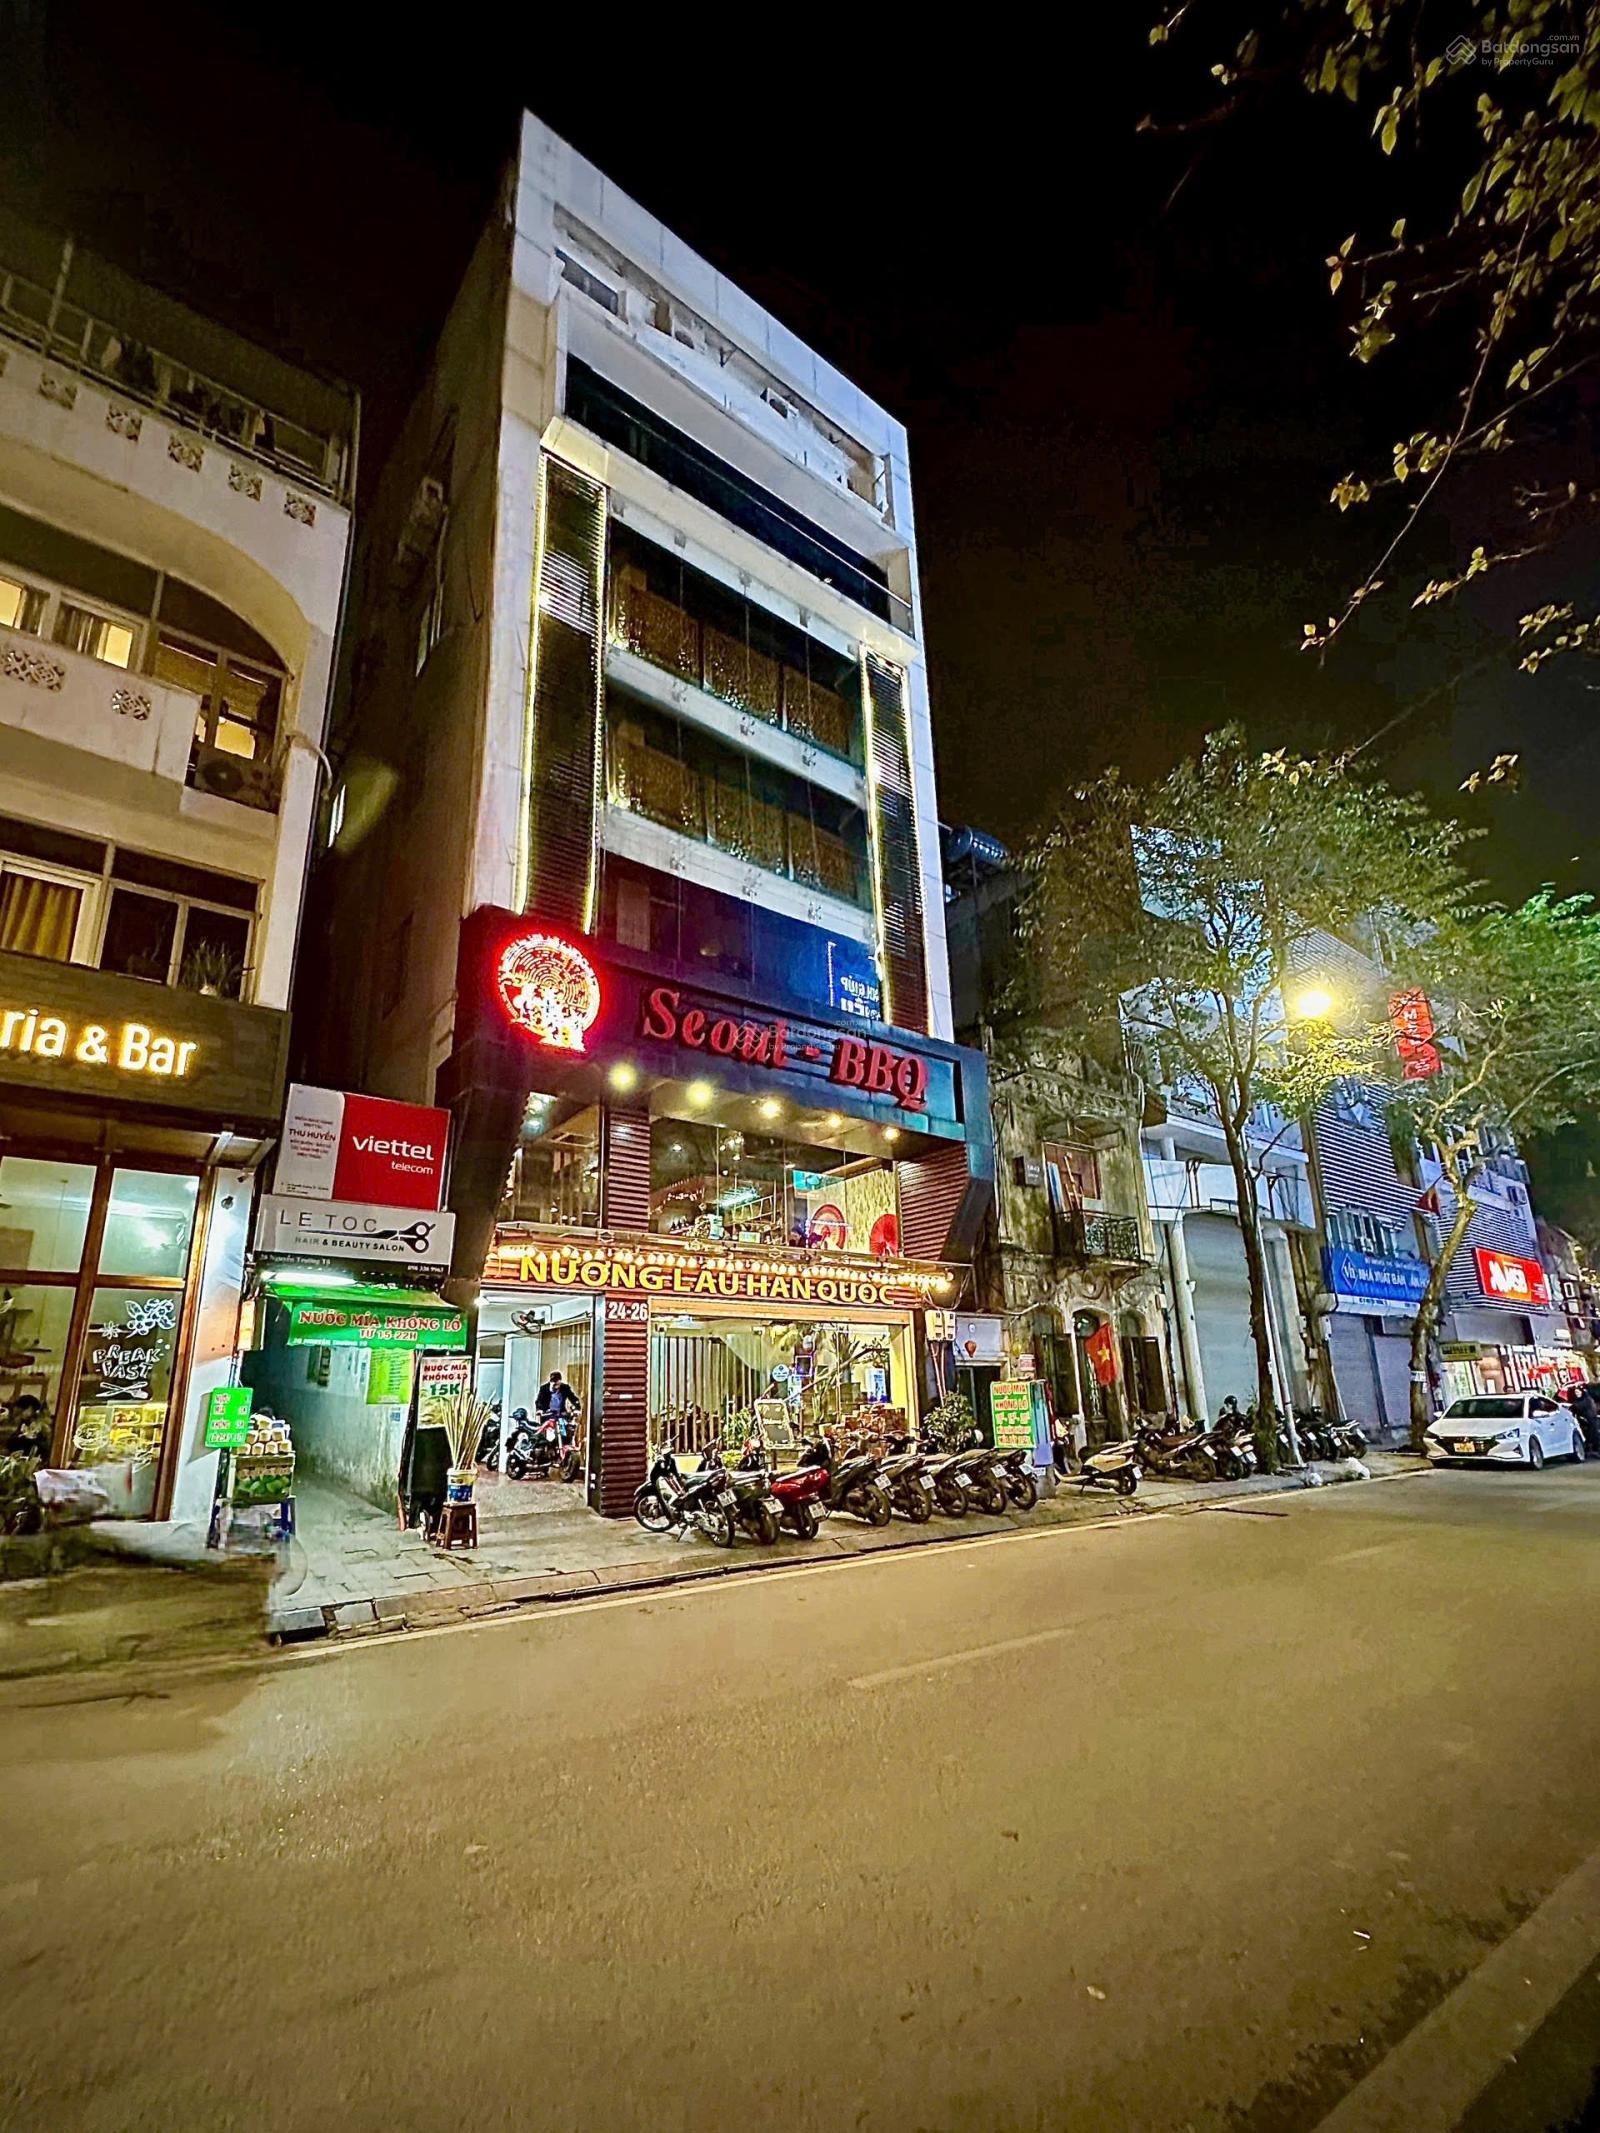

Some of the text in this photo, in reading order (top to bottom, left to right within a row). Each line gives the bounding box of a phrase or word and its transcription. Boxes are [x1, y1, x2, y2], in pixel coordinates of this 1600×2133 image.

[78, 1025, 109, 1063] &
[118, 1022, 199, 1076] Bar
[643, 988, 789, 1068] Seoul
[830, 1037, 928, 1112] BBQ
[352, 1136, 434, 1160] viettel
[391, 1161, 433, 1174] telecom
[279, 1209, 378, 1233] LE TOC
[331, 1240, 371, 1250] BEAUTY
[373, 1243, 405, 1253] SALON
[608, 1301, 649, 1321] 24-26
[430, 1383, 461, 1396] 15K
